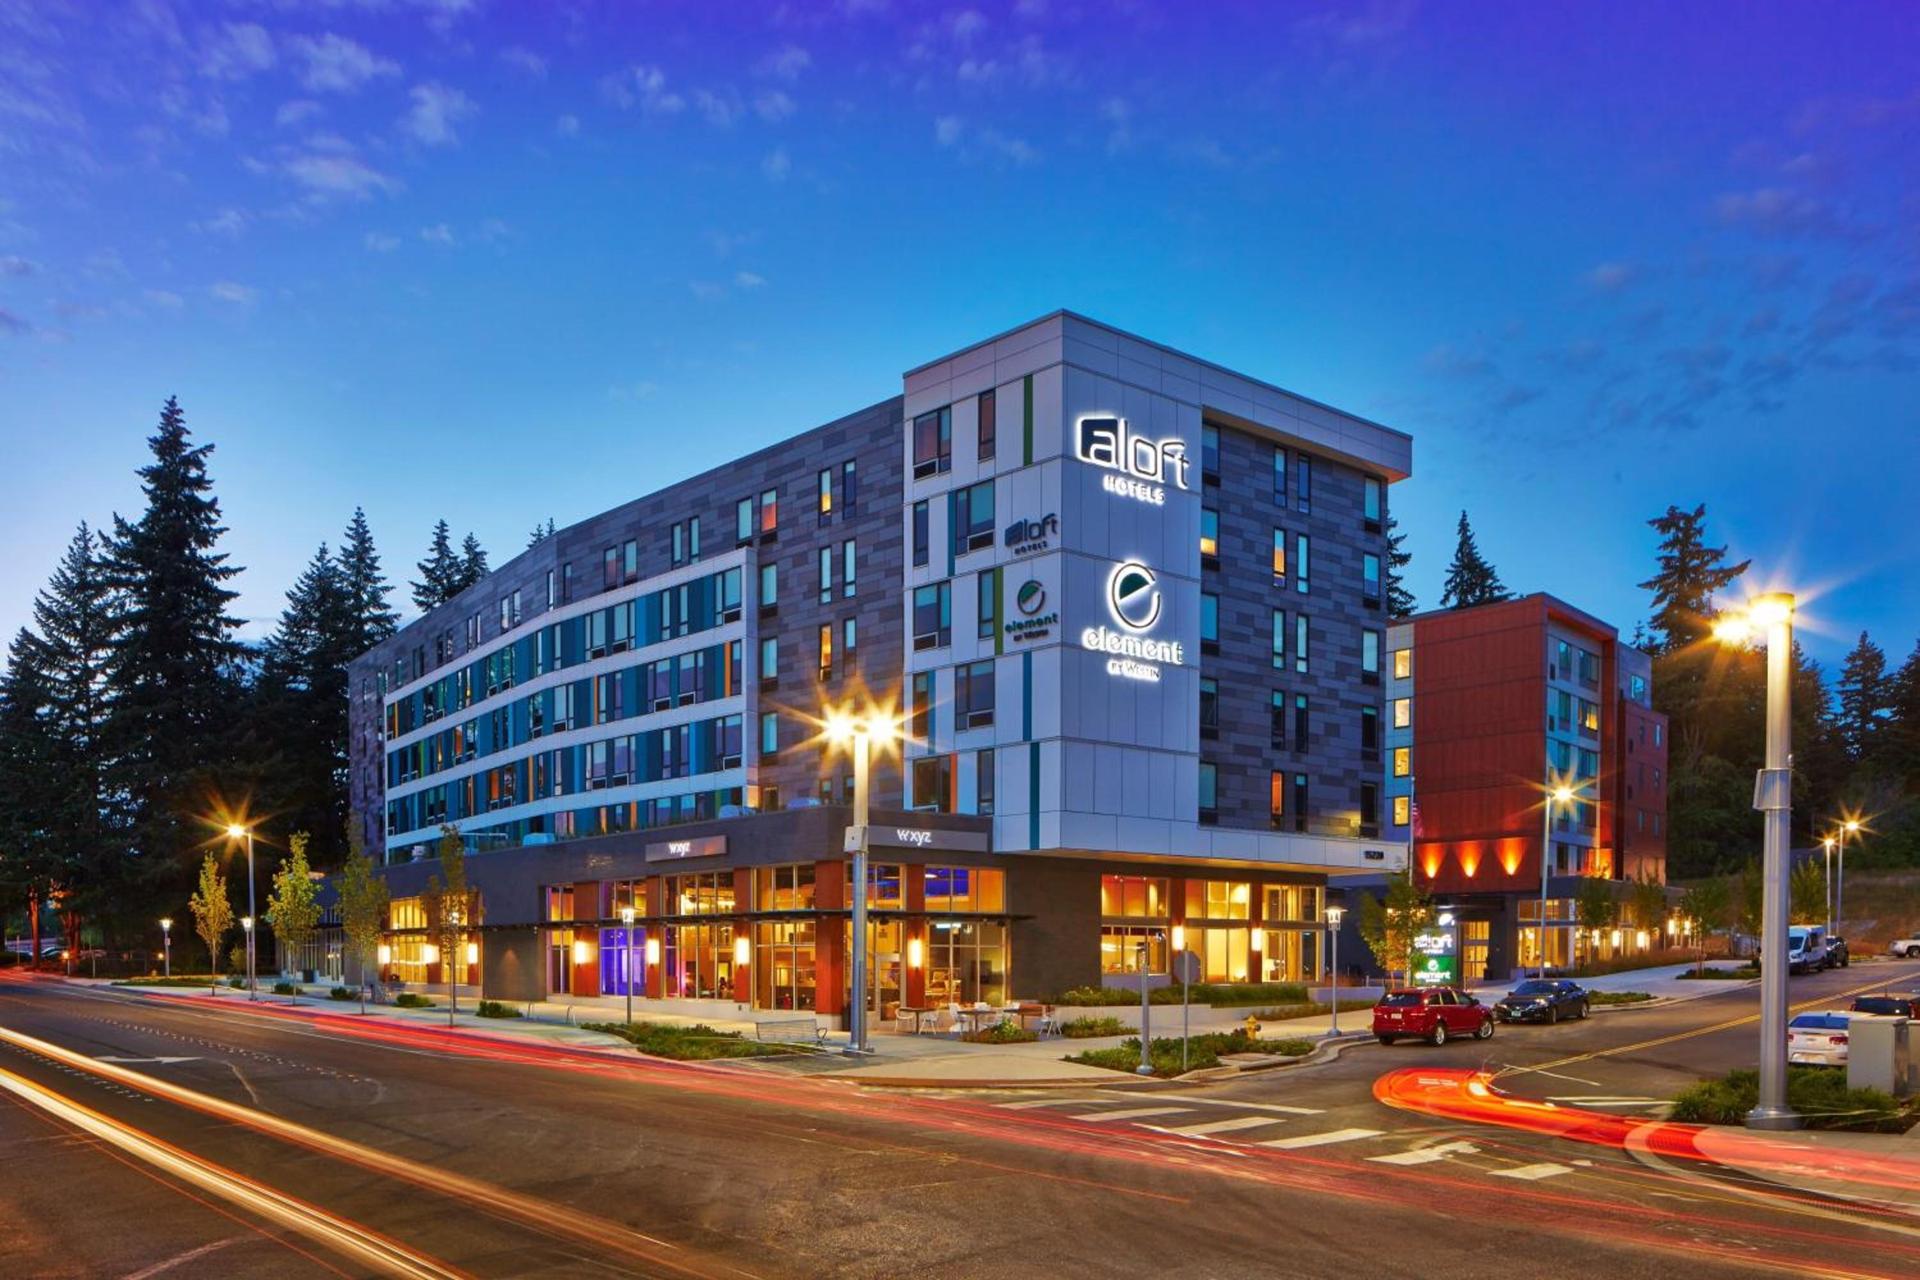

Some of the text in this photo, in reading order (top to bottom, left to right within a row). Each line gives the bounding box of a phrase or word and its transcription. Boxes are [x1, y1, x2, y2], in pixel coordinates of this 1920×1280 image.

[1076, 415, 1190, 490] aloft
[1103, 474, 1165, 506] HOTELS
[1004, 612, 1059, 633] element
[1082, 626, 1184, 665] element
[668, 841, 691, 857] wxyz
[896, 829, 932, 847] wxyz
